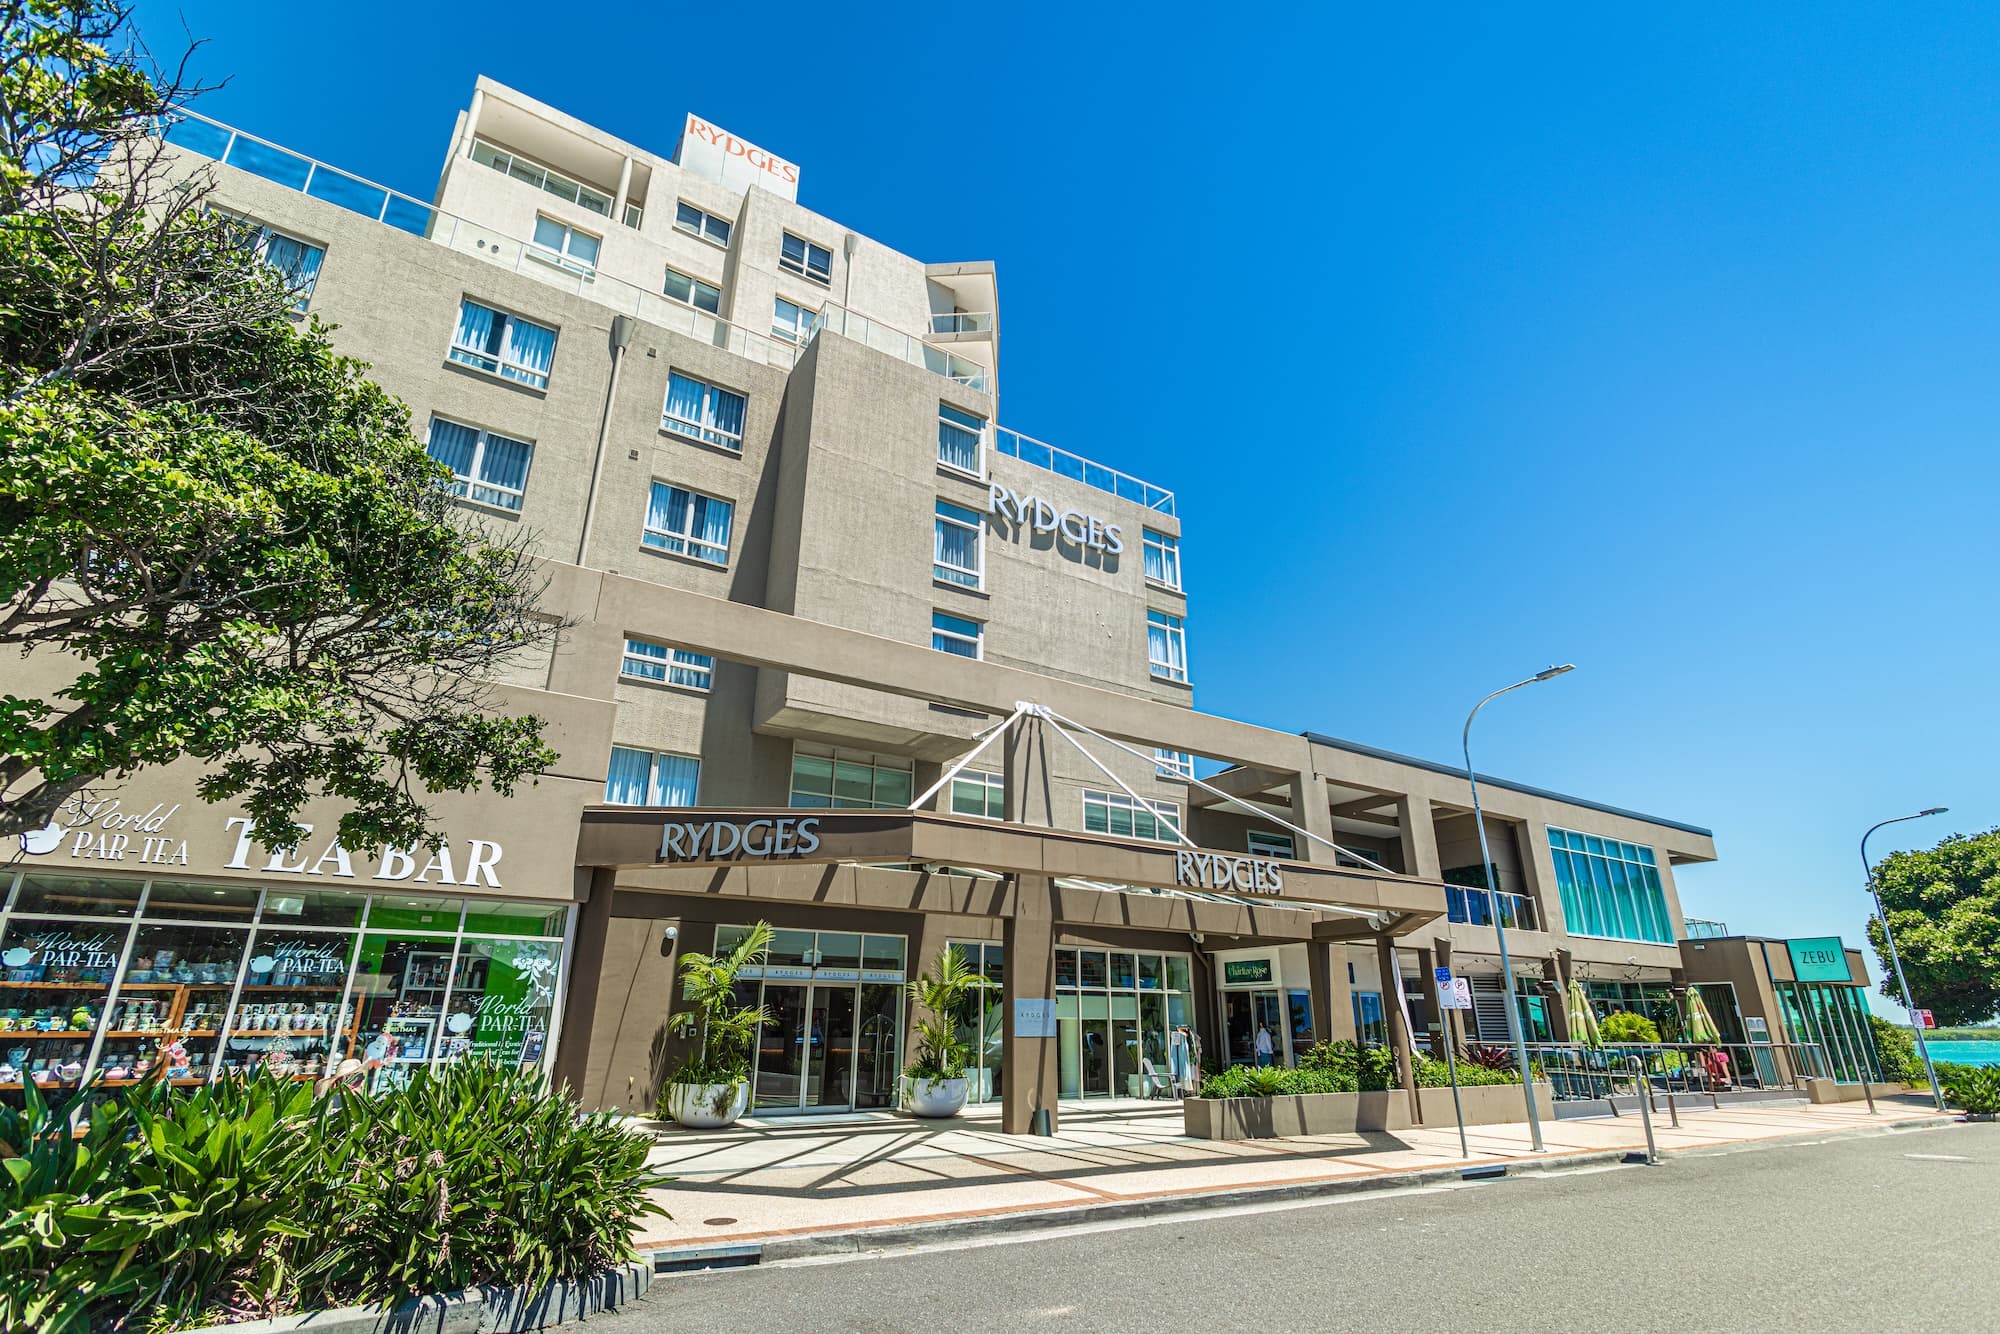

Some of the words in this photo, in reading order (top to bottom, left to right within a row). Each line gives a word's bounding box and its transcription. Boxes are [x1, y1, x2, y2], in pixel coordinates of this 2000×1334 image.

[689, 118, 798, 184] RYDGES
[988, 483, 1124, 554] RYDGES
[71, 831, 189, 866] PAR-TEA
[660, 818, 820, 858] RYDGES
[223, 817, 355, 878] TEA
[372, 837, 503, 888] BAR
[1177, 850, 1281, 891] RYDGES
[31, 931, 115, 951] World
[274, 941, 341, 959] World
[41, 951, 118, 968] PAR-TEA
[281, 958, 345, 974] PAR-TEA
[1800, 950, 1836, 964] ZEBU
[469, 994, 541, 1015] World
[480, 1014, 545, 1032] PAR-TEA
